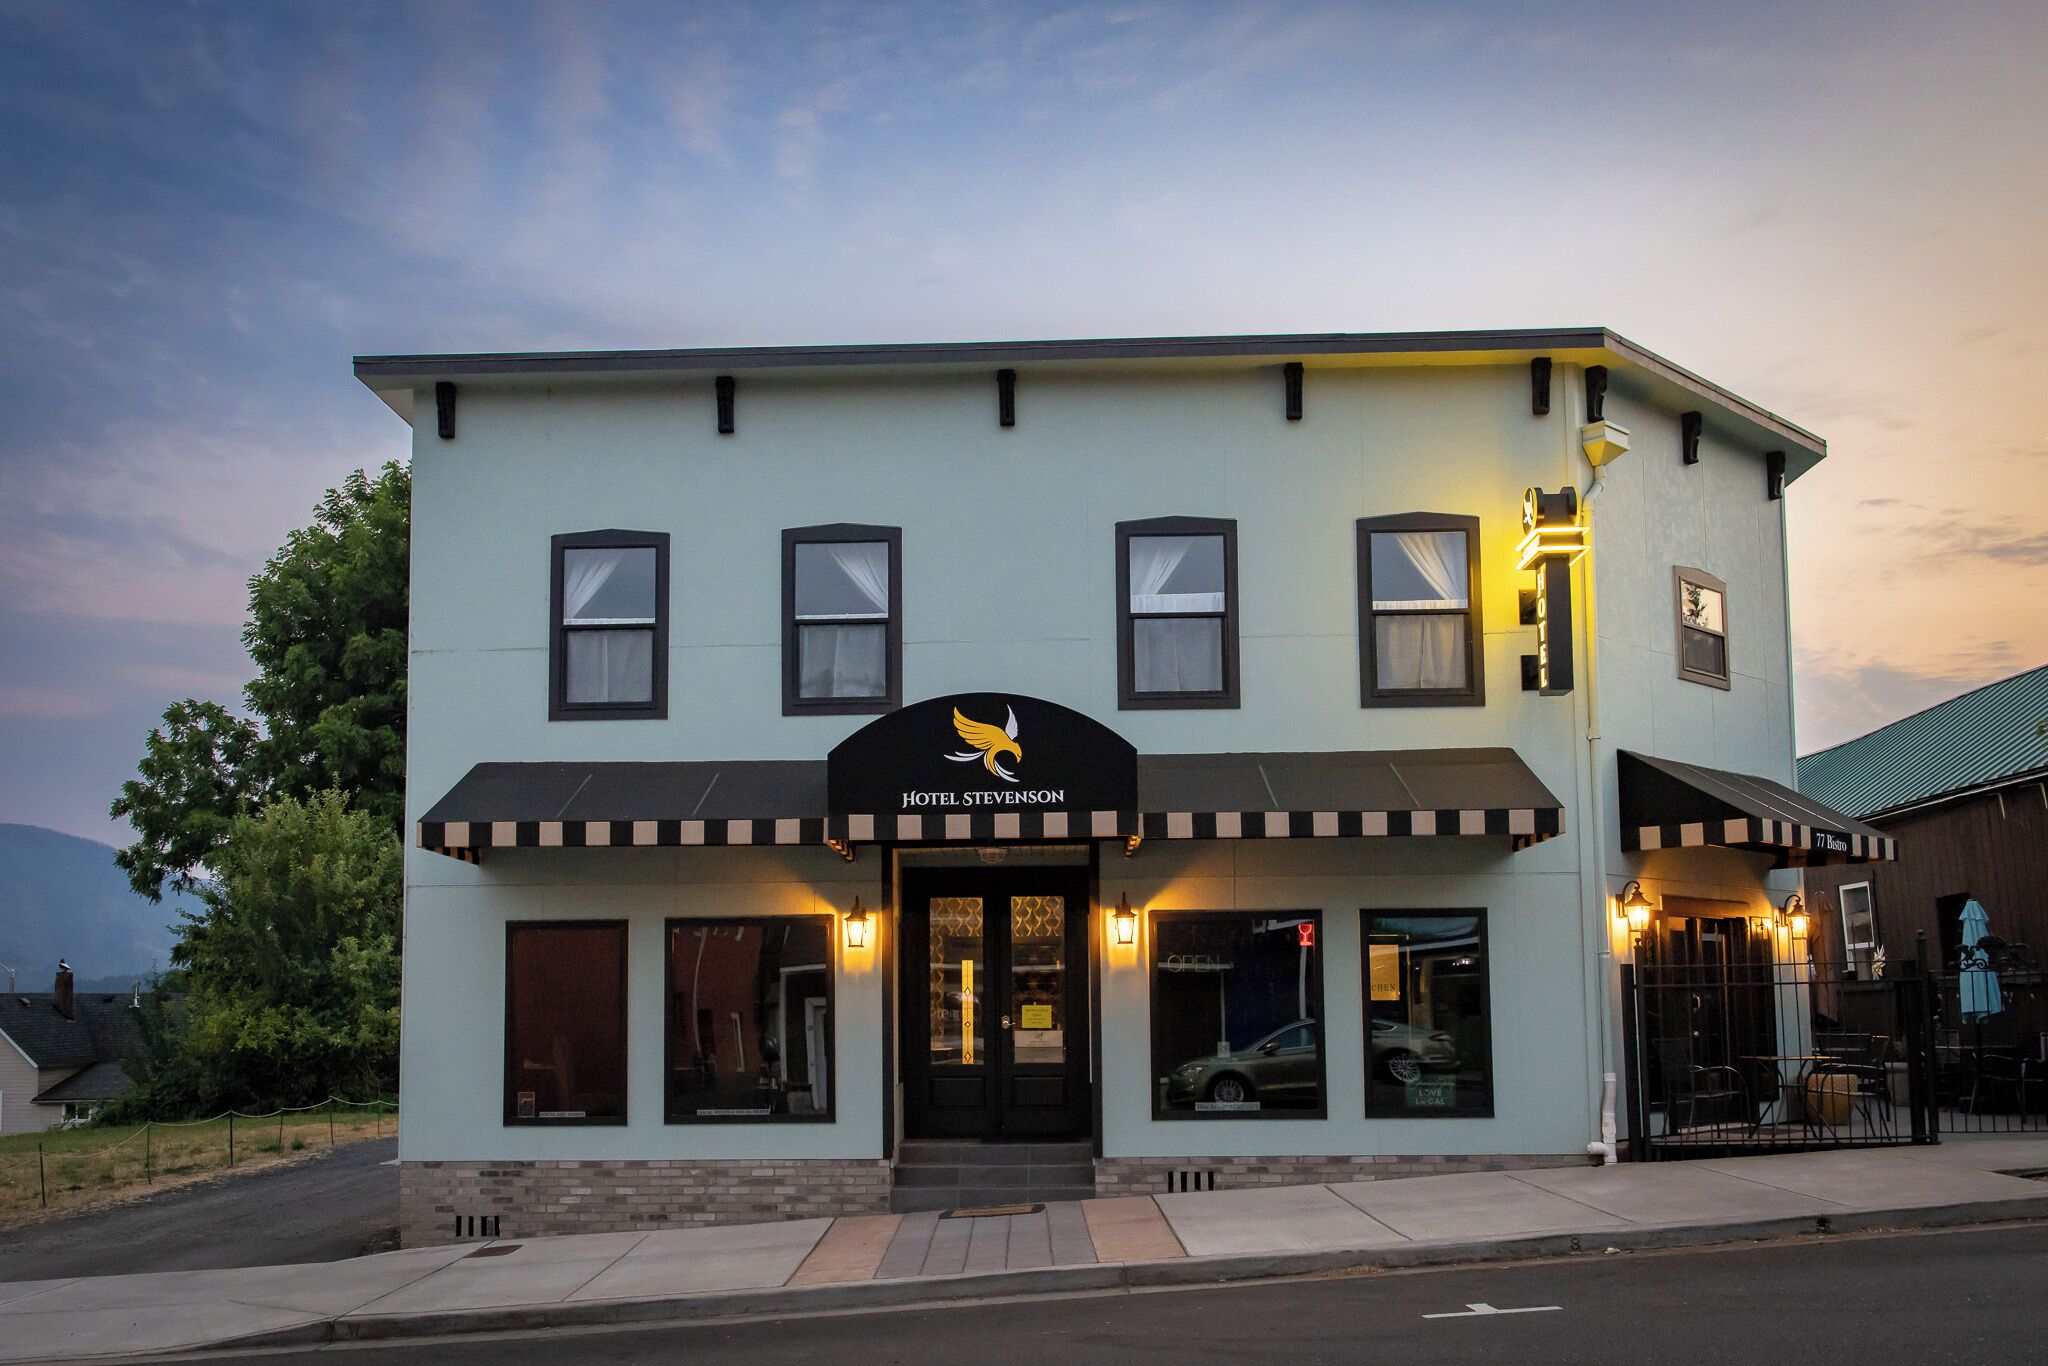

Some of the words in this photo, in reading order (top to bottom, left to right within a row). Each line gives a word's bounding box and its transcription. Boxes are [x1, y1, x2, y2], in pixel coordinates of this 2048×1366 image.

[1537, 565, 1548, 688] HOTEL
[902, 790, 959, 808] HOTEL
[962, 789, 1065, 806] STEVENSON
[1816, 832, 1825, 848] 77
[1826, 834, 1847, 851] Bistro
[1167, 954, 1220, 973] OPEN
